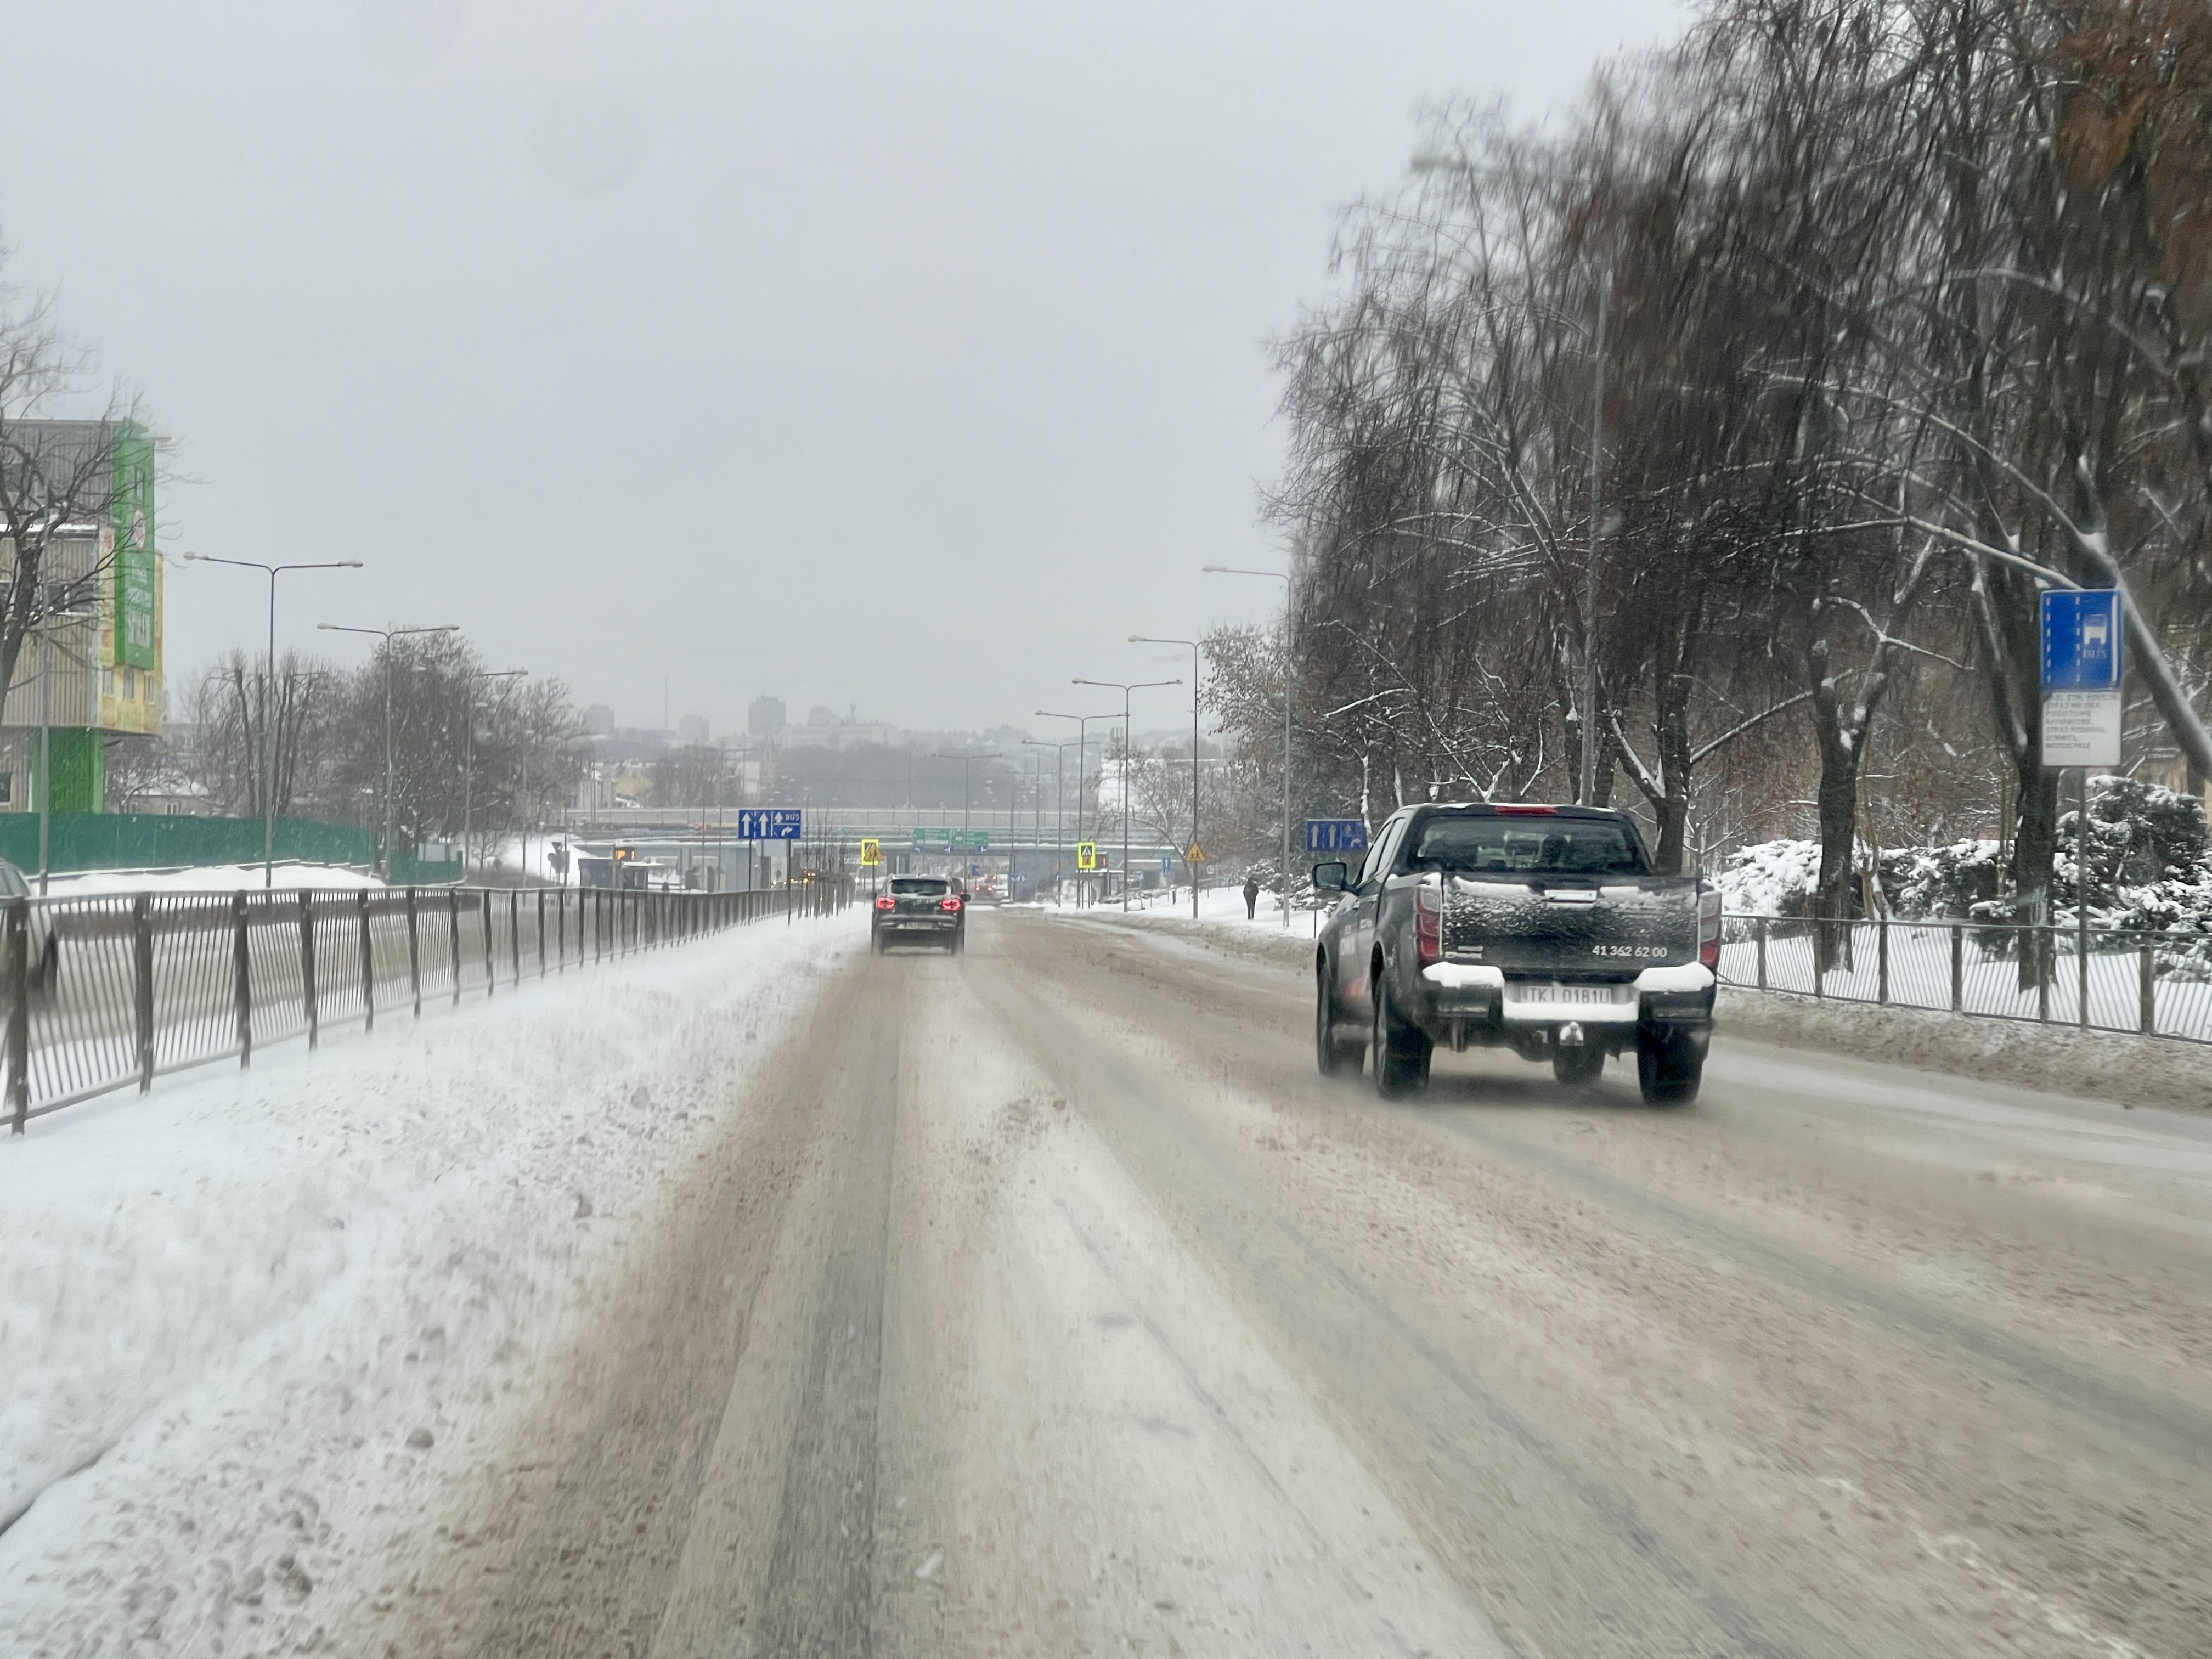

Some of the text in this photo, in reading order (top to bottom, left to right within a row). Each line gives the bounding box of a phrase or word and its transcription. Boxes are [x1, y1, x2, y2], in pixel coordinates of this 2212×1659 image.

[1592, 945, 1668, 957] 41 362 62 00
[1528, 988, 1555, 1002] TKI
